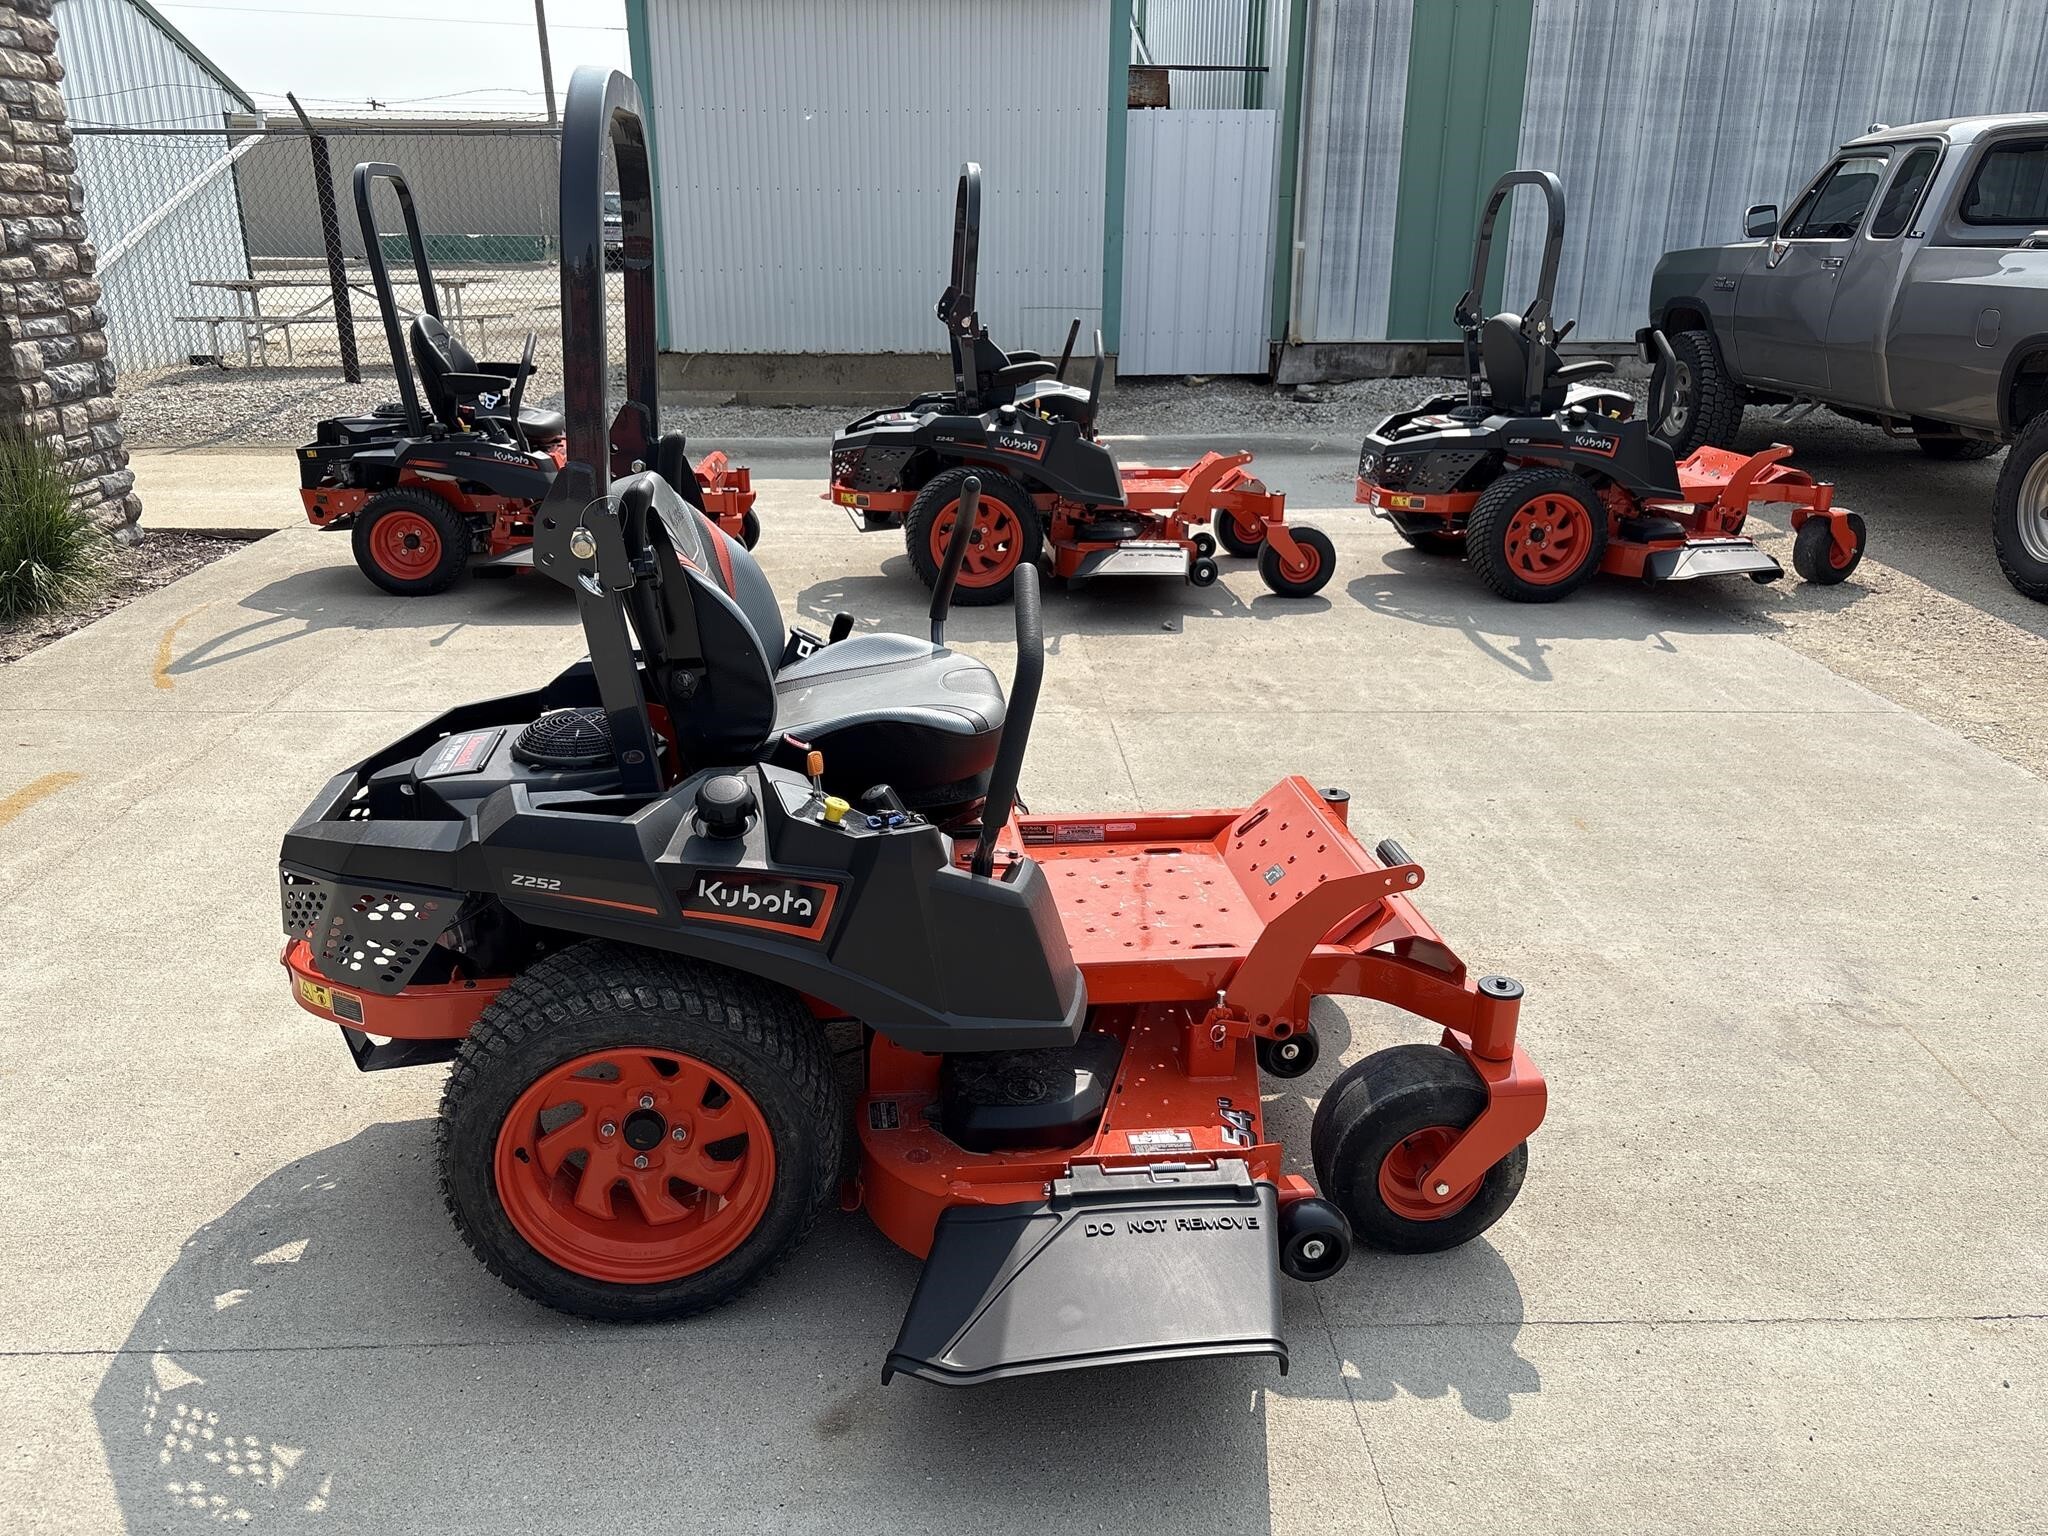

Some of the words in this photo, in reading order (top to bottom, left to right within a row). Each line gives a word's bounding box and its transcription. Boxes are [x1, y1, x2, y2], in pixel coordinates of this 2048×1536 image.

[999, 435, 1038, 452] Kubota
[1575, 434, 1612, 449] Kubota
[494, 450, 530, 465] Kubota
[511, 874, 562, 891] Z252
[698, 879, 812, 917] Kubota
[1085, 1221, 1116, 1238] DO
[1127, 1218, 1168, 1235] NOT
[1174, 1215, 1260, 1232] REMOVE
